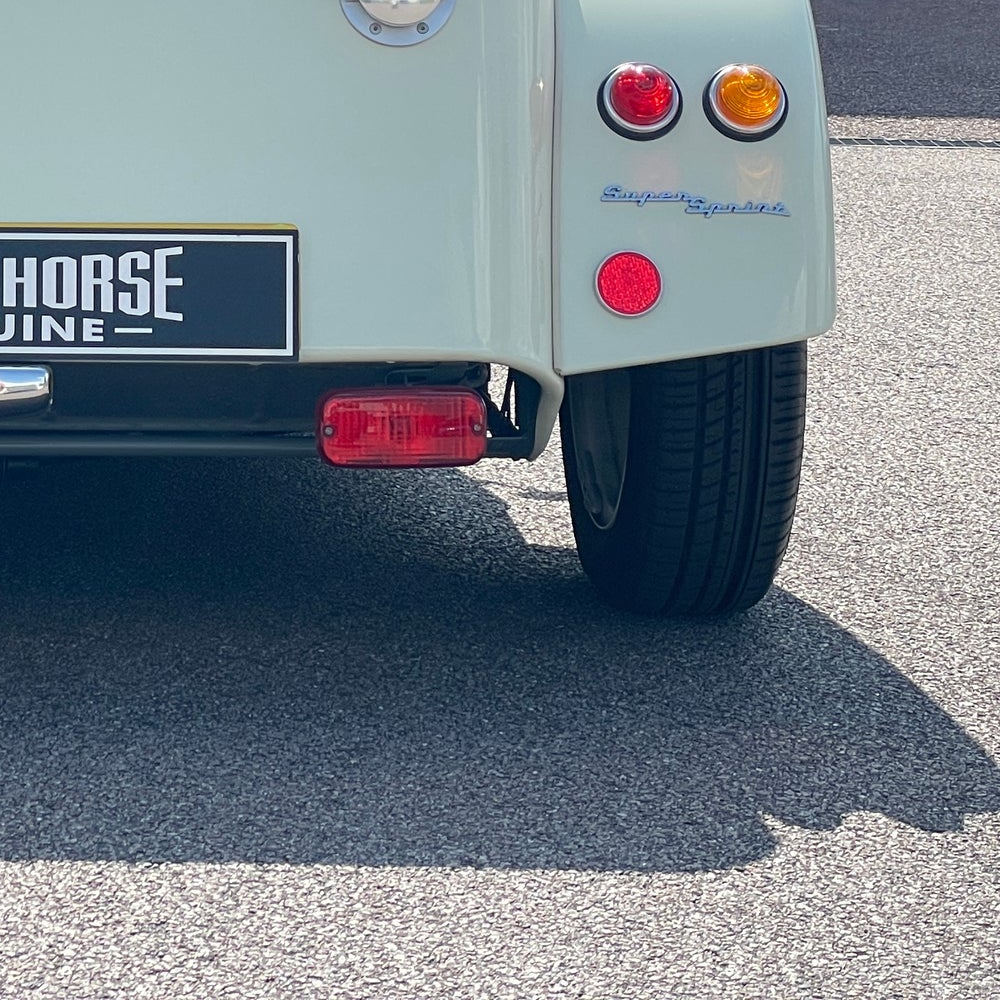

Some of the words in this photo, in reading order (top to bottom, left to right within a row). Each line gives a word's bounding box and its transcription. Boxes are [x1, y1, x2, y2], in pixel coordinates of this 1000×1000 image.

[601, 185, 691, 207] Super
[684, 196, 791, 218] Sprint
[3, 245, 184, 322] HORSE
